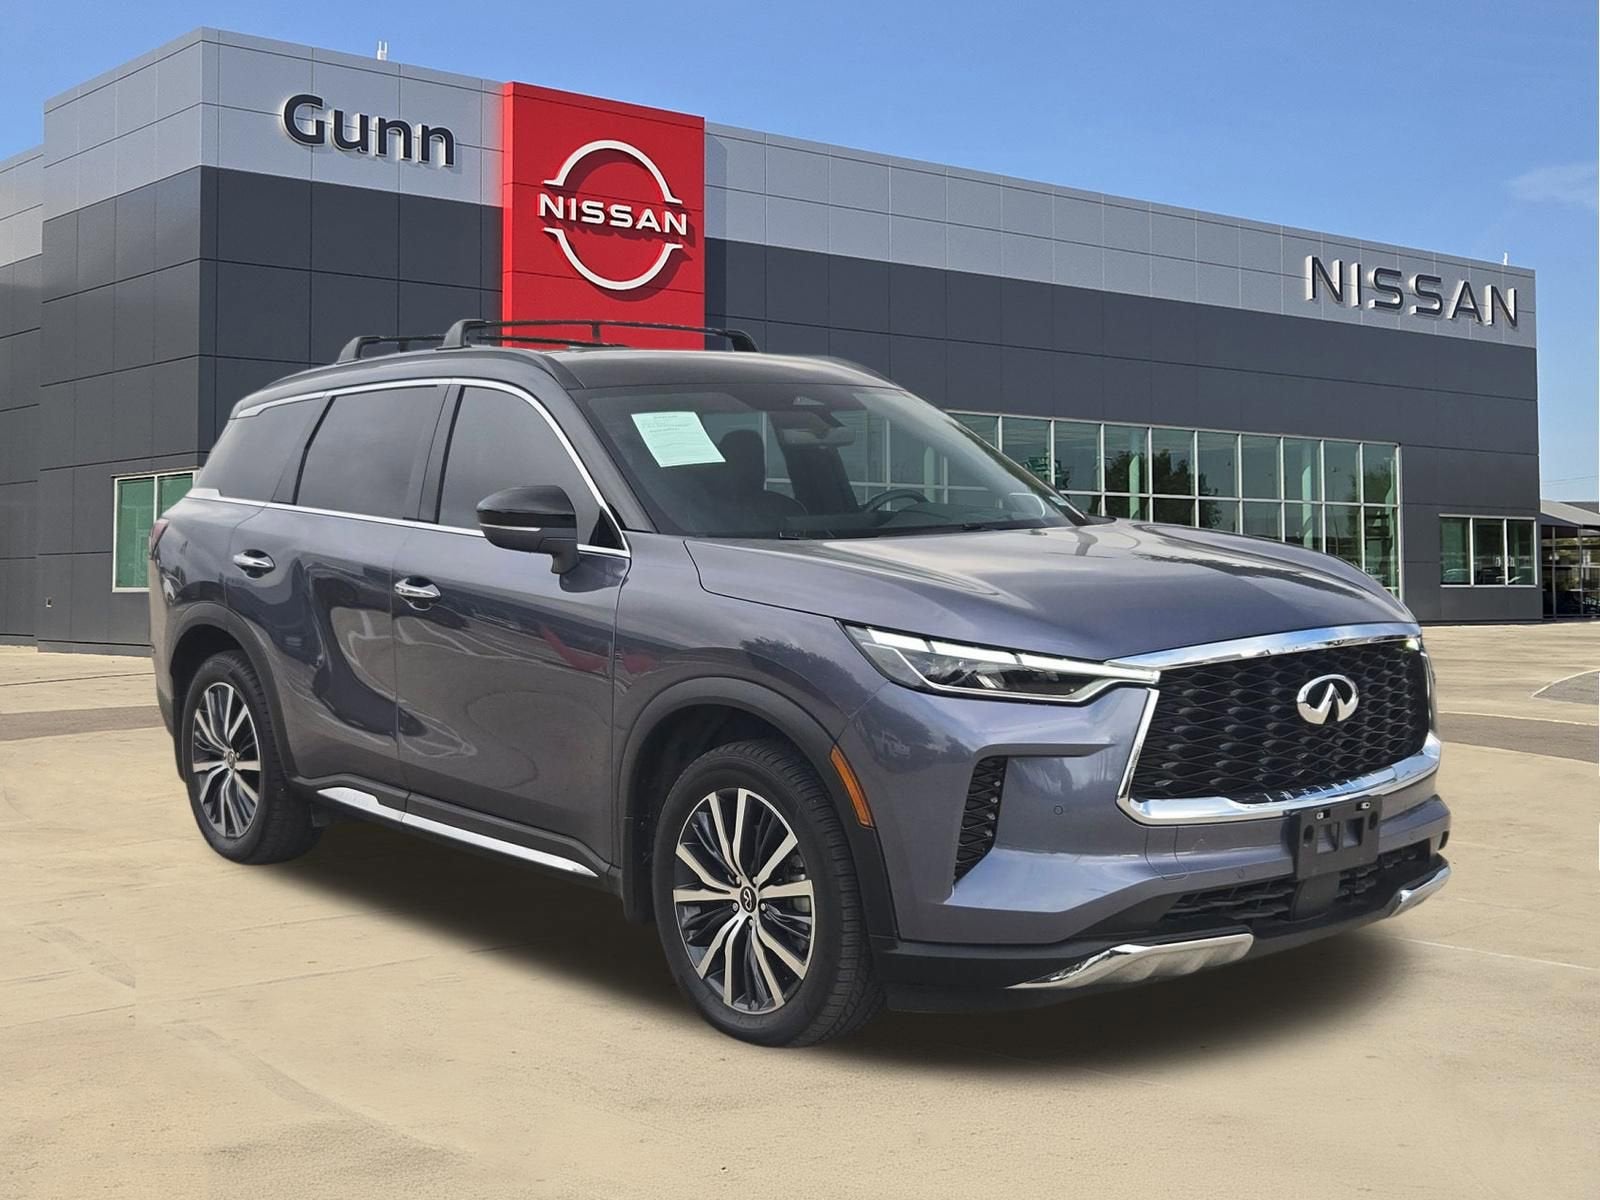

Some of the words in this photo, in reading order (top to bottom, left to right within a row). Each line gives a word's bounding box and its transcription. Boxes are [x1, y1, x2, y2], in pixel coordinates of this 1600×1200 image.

[281, 93, 455, 167] Gunn
[537, 192, 688, 237] NISSAN
[1305, 255, 1518, 328] NISSAN
